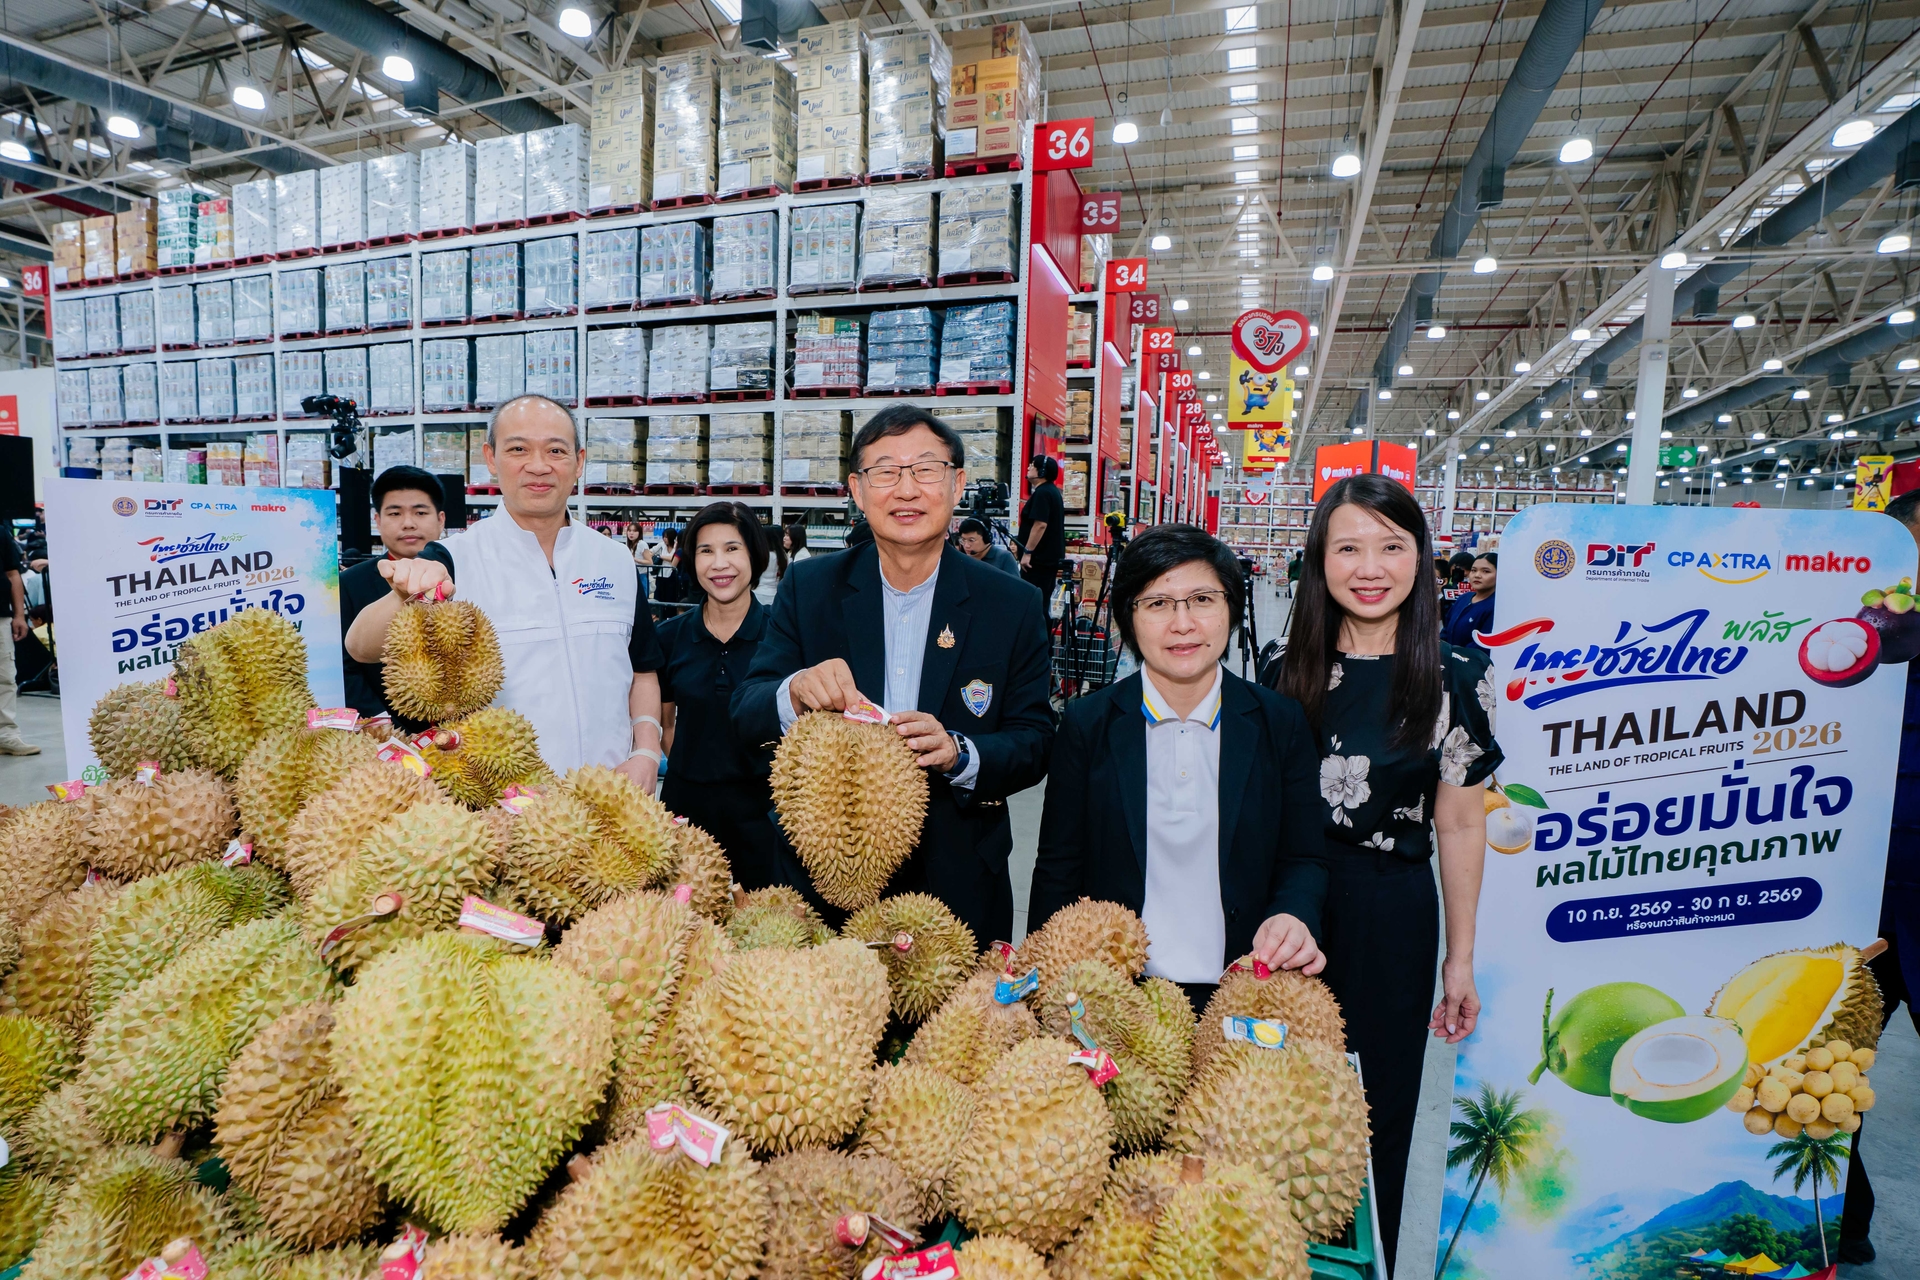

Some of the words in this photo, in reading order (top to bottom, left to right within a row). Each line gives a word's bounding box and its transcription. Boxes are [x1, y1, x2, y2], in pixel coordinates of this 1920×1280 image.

[1048, 127, 1090, 160] 36
[1082, 200, 1118, 227] 35
[24, 271, 42, 291] 36
[1115, 264, 1145, 286] 34
[1131, 300, 1158, 318] 33
[1149, 332, 1173, 349] 32
[1160, 353, 1178, 368] 31
[1172, 374, 1191, 388] 30
[1178, 388, 1196, 401] 29
[1185, 402, 1202, 415] 28
[1196, 424, 1210, 434] 26
[1204, 439, 1217, 448] 24
[1331, 466, 1353, 478] makro
[1389, 469, 1404, 480] makro
[251, 503, 287, 513] makro
[1785, 550, 1872, 574] makro
[106, 550, 273, 598] THAILAND
[245, 566, 295, 587] 2026
[1586, 569, 1650, 578] กรมการค้าภายใน
[115, 599, 132, 608] THE
[134, 595, 158, 605] LAND
[159, 592, 171, 600] OF
[172, 585, 212, 597] TROPICAL
[213, 579, 241, 589] FRUITS
[1473, 608, 1748, 702] ไทยช่วยไทย
[1722, 610, 1812, 644] พลัส
[1542, 688, 1807, 758] THAILAND
[1752, 721, 1842, 755] 2026
[1548, 764, 1573, 777] THE
[1575, 759, 1610, 773] LAND
[1613, 756, 1630, 768] OF
[1633, 747, 1697, 766] TROPICAL
[1699, 740, 1744, 757] FRUITS
[1534, 759, 1853, 852] อร่อยมั่นใจ
[1535, 828, 1842, 889] ผลไม้ไทยคุณภาพ
[1567, 909, 1587, 923] 10
[1593, 907, 1623, 921] ก.ย.
[1629, 900, 1672, 917] 2569
[1691, 897, 1712, 911] 30
[1758, 887, 1802, 904] 2569
[1626, 912, 1735, 932] หรือจนกว่าสินค้าจะหมด
